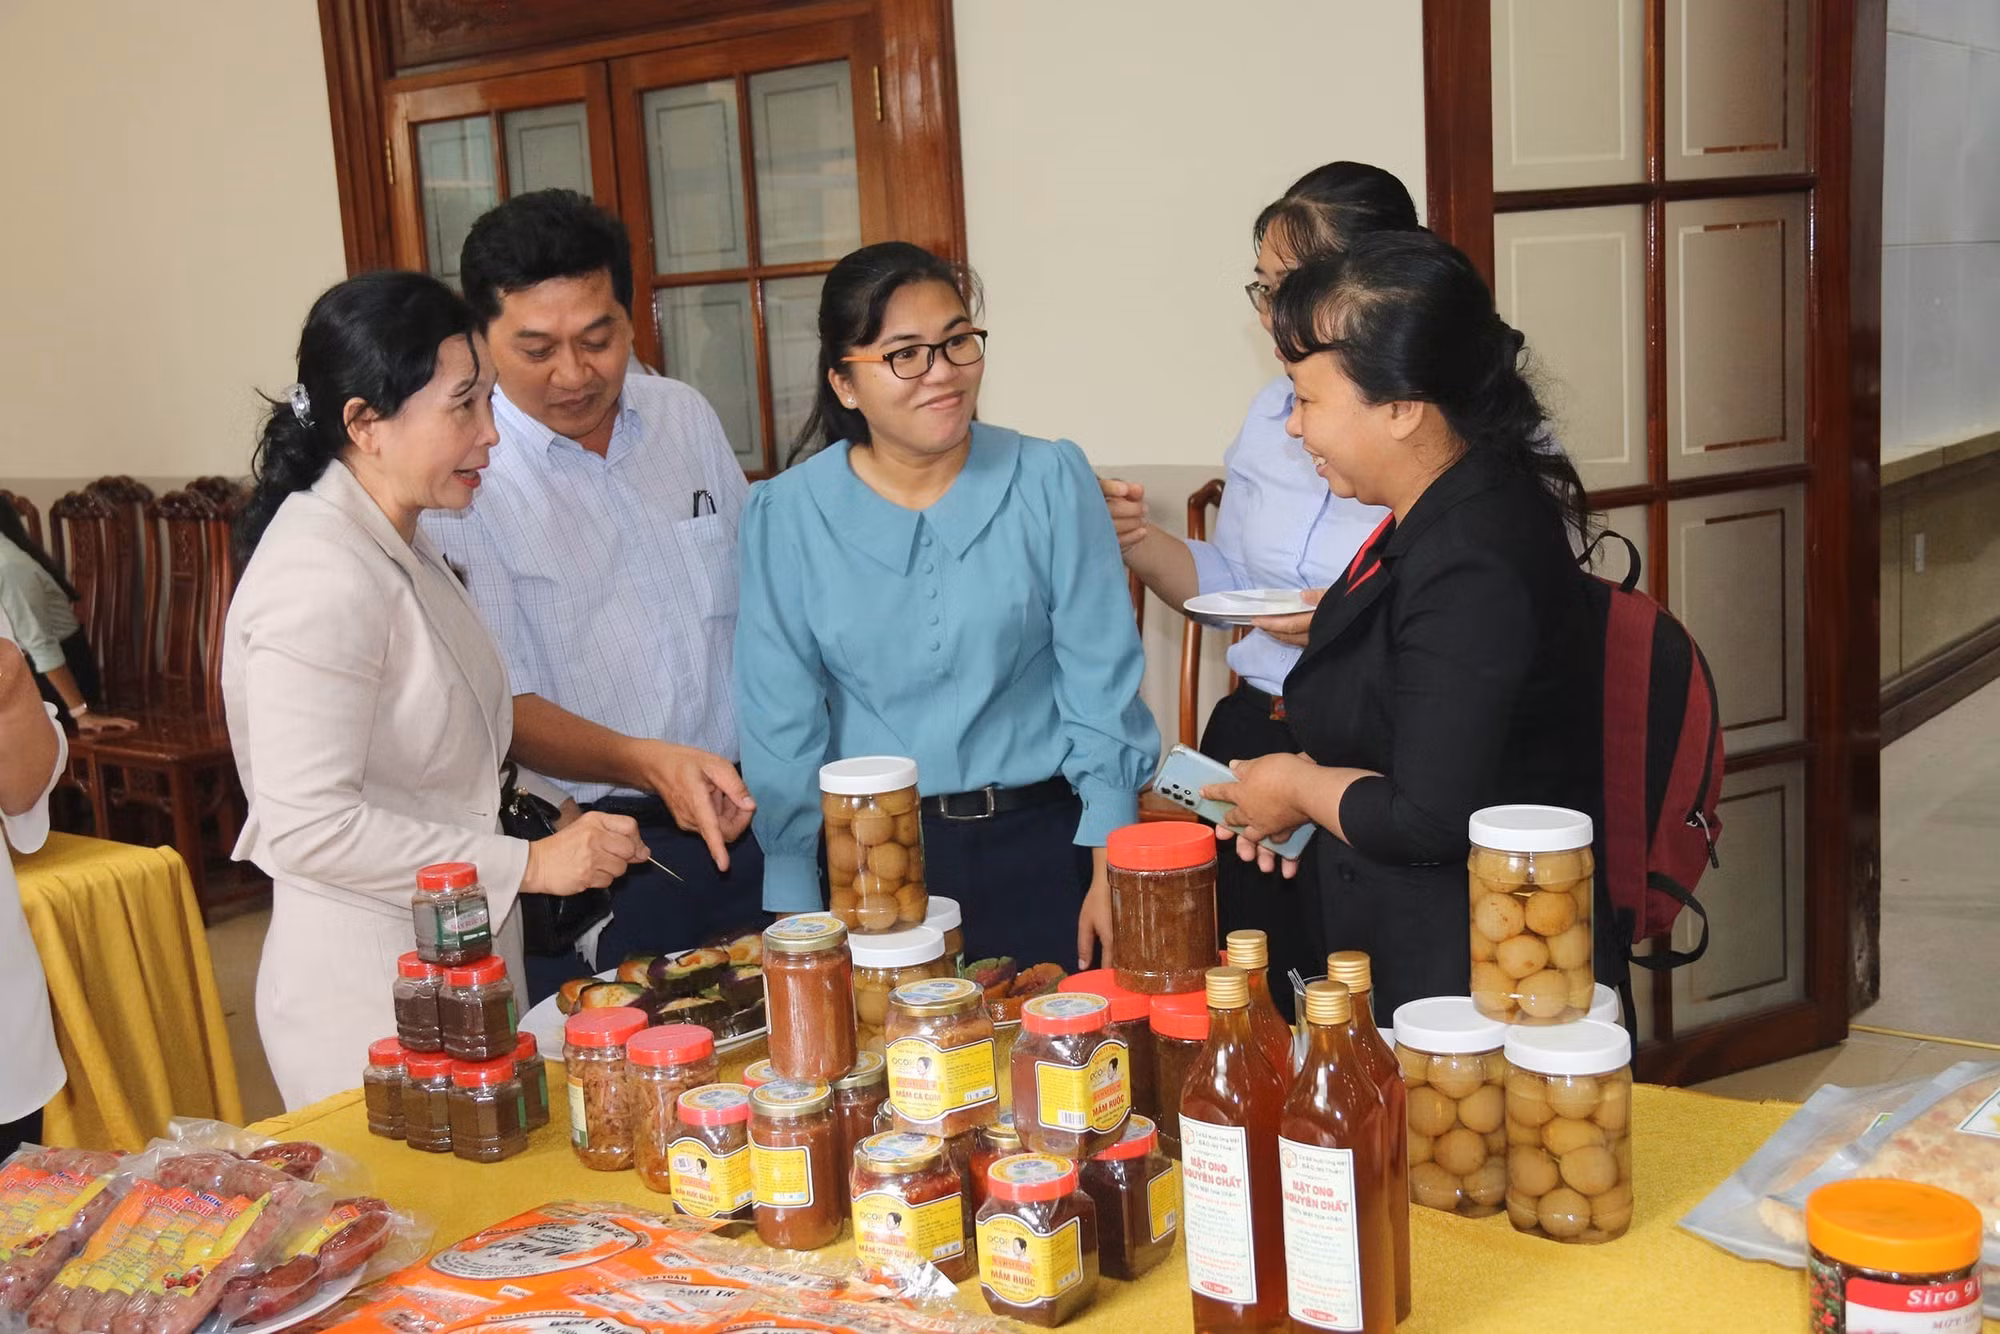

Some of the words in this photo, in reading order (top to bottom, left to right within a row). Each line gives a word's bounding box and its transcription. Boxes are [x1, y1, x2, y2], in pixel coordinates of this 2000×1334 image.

[1208, 1162, 1228, 1173] ONG
[1215, 1175, 1242, 1188] CHẤT
[1312, 1185, 1334, 1198] ONG
[1320, 1200, 1349, 1213] CHẤT
[1906, 1288, 1959, 1306] Siro
